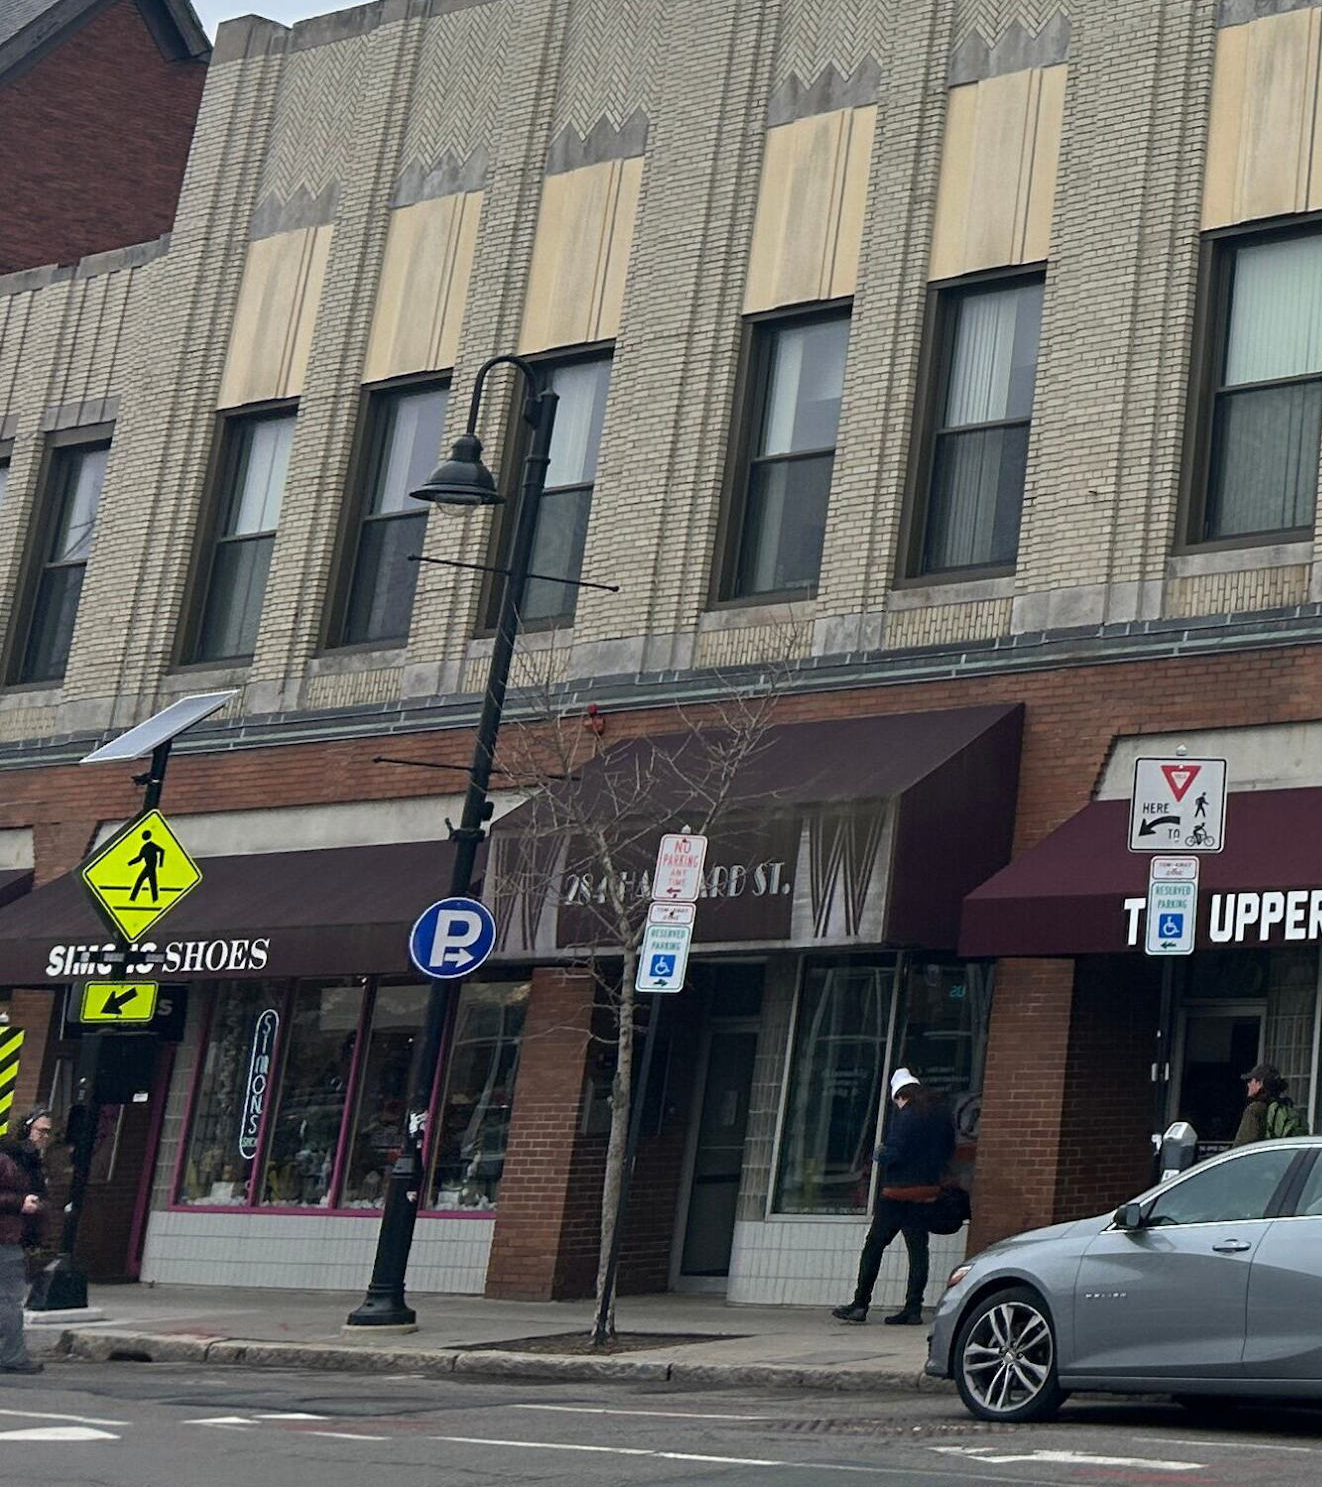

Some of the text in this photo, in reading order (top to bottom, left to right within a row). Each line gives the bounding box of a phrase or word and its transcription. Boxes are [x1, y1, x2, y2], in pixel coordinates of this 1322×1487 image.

[1142, 802, 1171, 815] HERE
[1167, 828, 1181, 840] TO
[674, 840, 693, 855] NO
[663, 854, 699, 868] PARKING
[670, 869, 687, 877] ANY
[1154, 885, 1192, 896] RESERVED
[1158, 899, 1188, 909] PARKING
[650, 928, 687, 939] RESERVED
[650, 942, 681, 951] PARKING
[162, 937, 271, 973] SHOES
